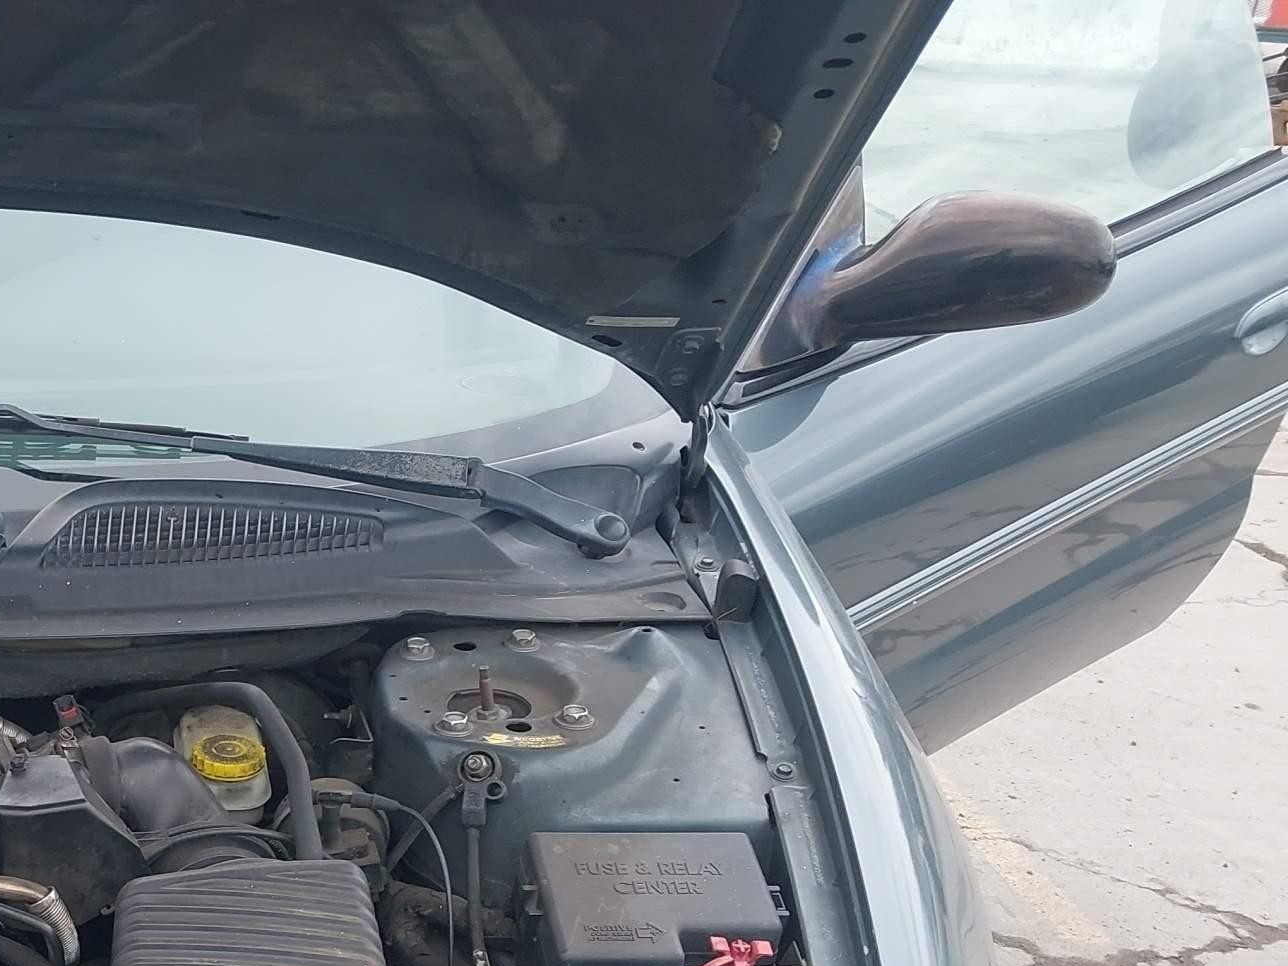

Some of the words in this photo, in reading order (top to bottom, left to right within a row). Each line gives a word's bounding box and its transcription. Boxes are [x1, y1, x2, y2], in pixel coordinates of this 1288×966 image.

[574, 862, 630, 876] FUSE
[635, 862, 652, 876] &
[657, 862, 724, 876] RELAY
[612, 880, 704, 895] CENTER
